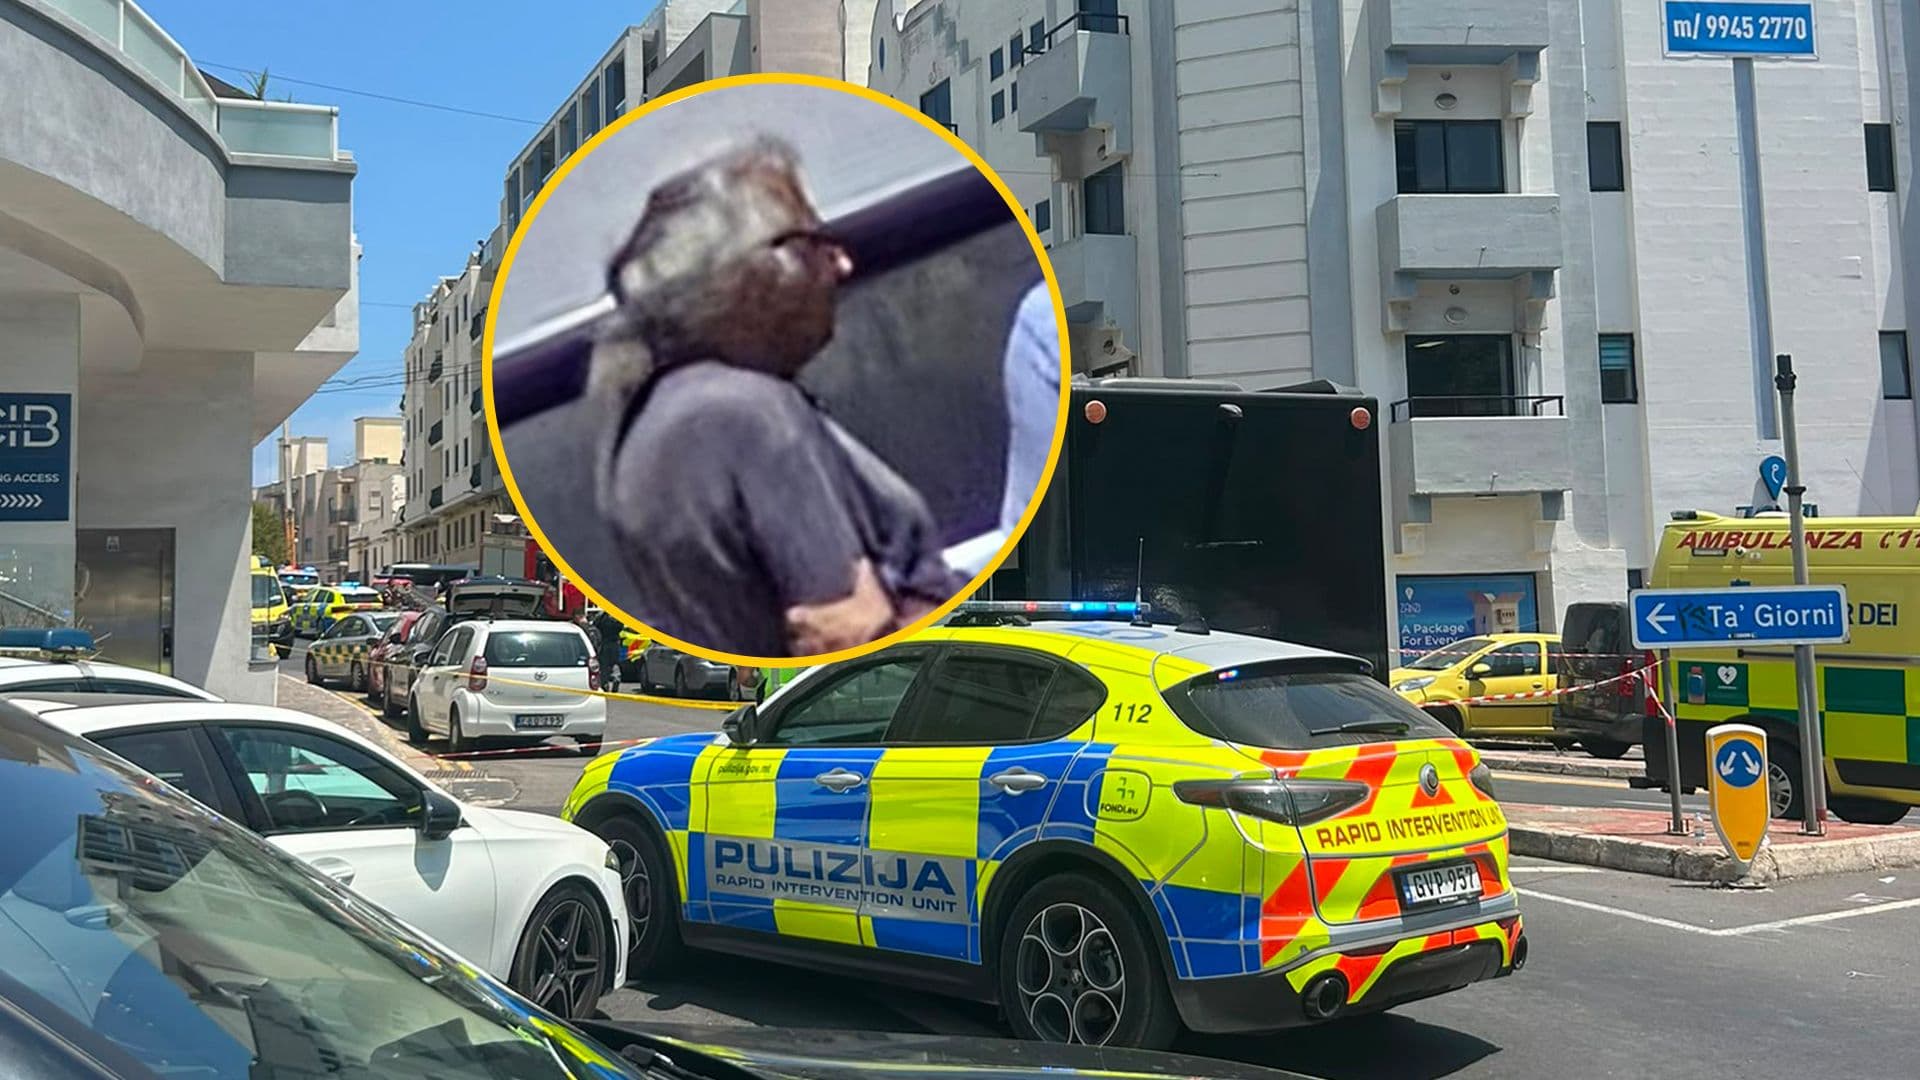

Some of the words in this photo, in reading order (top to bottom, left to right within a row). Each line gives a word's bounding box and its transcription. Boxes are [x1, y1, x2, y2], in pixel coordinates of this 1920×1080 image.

[1673, 13, 1700, 40] m/
[1706, 15, 1754, 39] 9945
[1758, 16, 1807, 40] 2770
[14, 473, 60, 483] ACCESS
[1677, 531, 1862, 549] AMBULANZA
[1707, 604, 1745, 628] Ta'
[1754, 603, 1835, 627] Giorni
[1860, 603, 1898, 626] DEI
[1401, 624, 1411, 634] A
[1413, 624, 1465, 635] Package
[1402, 636, 1422, 646] For
[1114, 703, 1152, 723] 112
[1317, 821, 1381, 848] RAPID
[1386, 809, 1488, 840] INTERVENTION
[715, 840, 955, 896] PULIZIJA
[716, 874, 765, 889] RAPID
[771, 880, 904, 906] INTERVENTION
[912, 897, 957, 913] UNIT
[1413, 872, 1443, 898] GVP
[1448, 866, 1474, 892] 957
